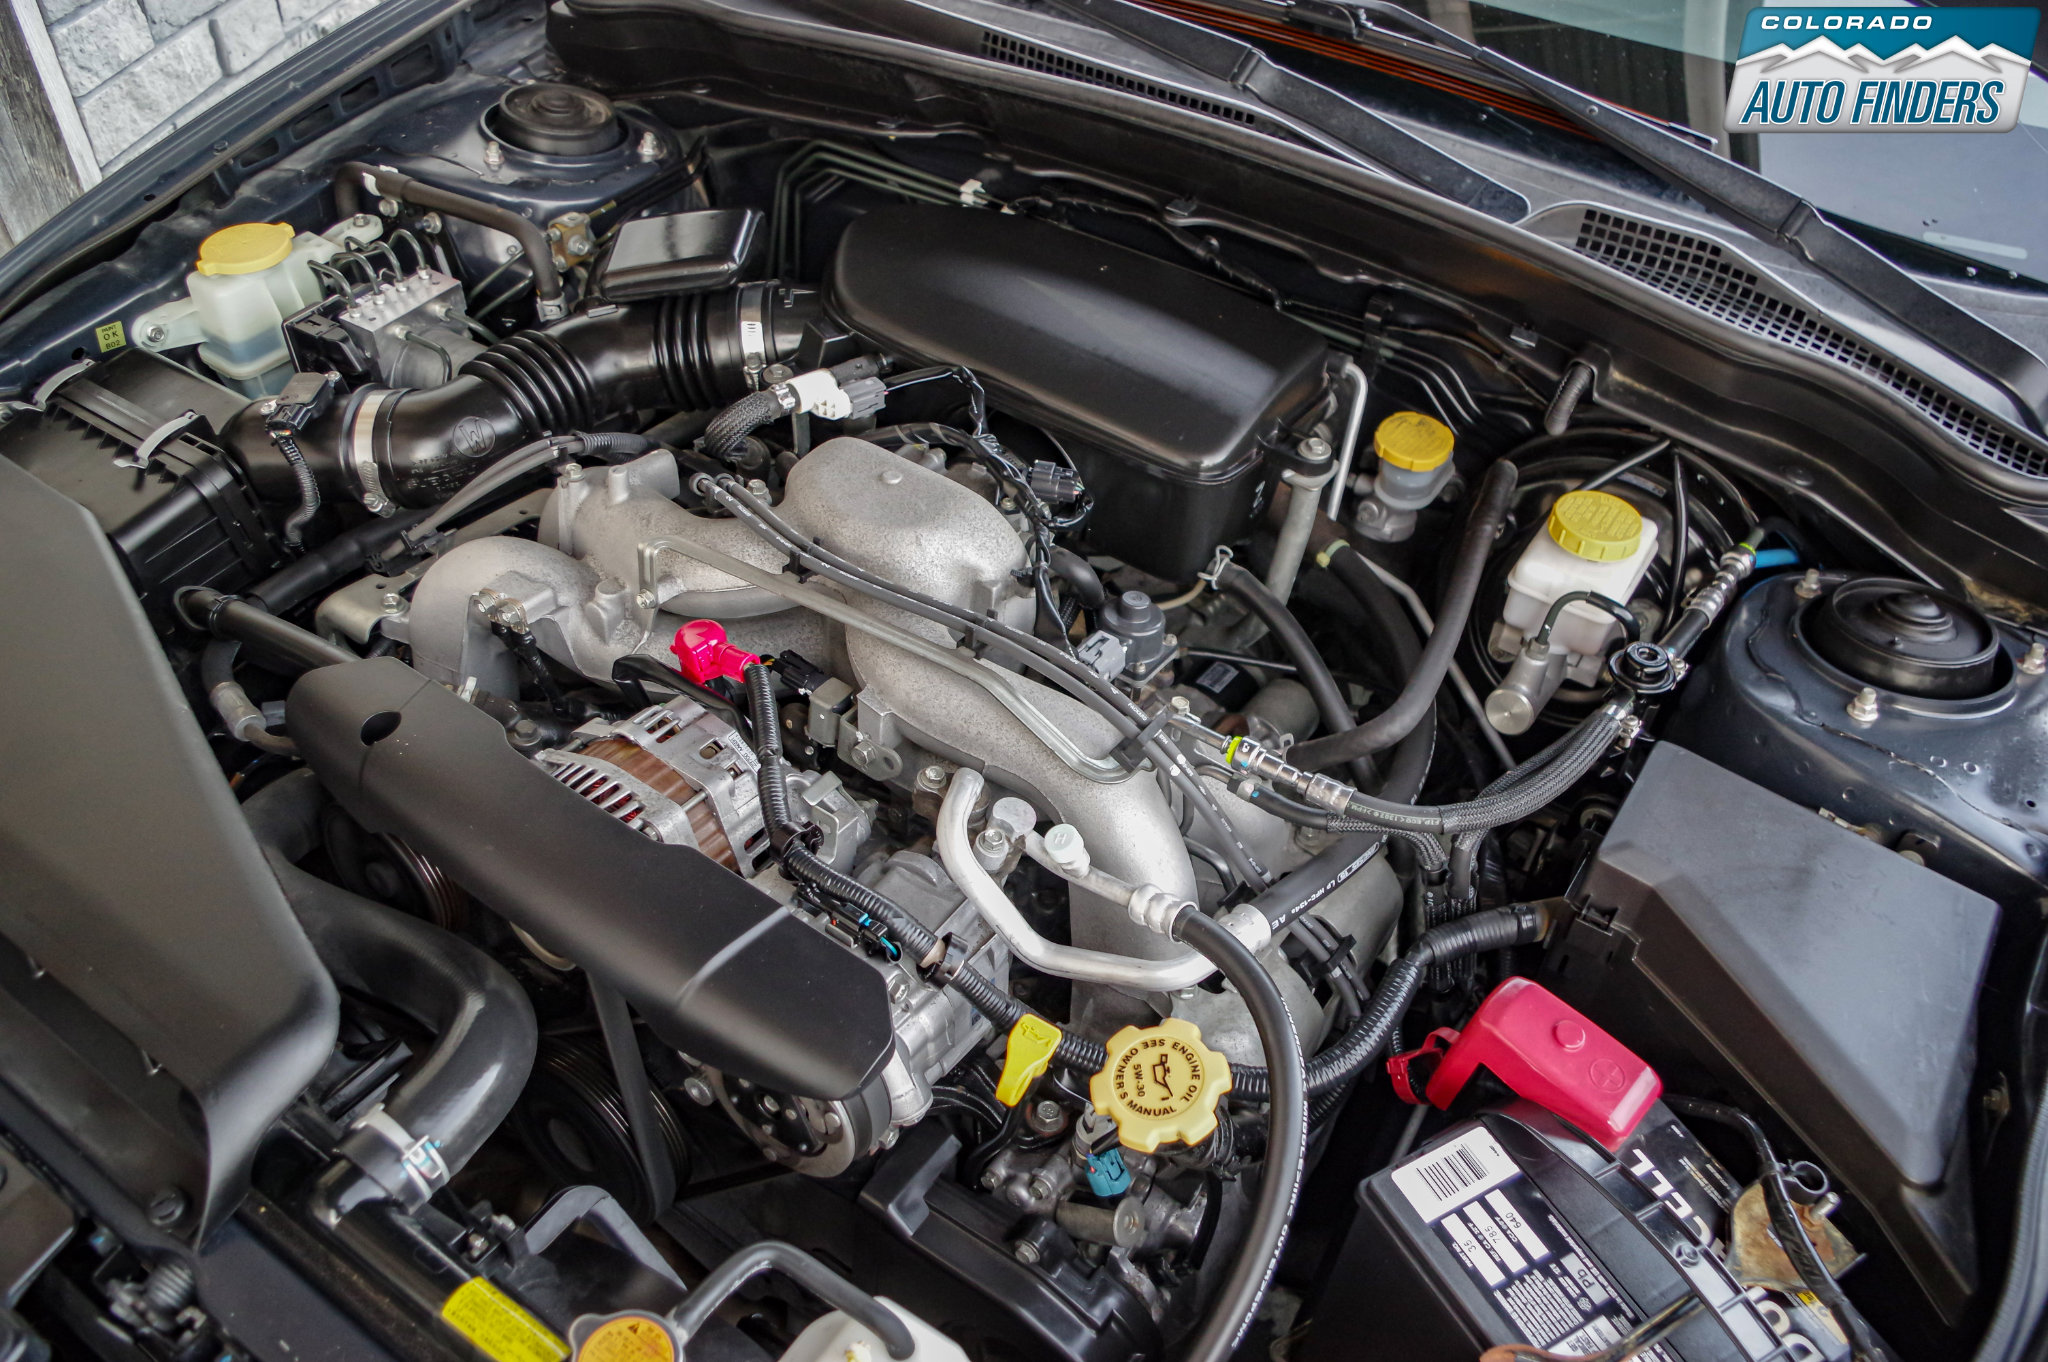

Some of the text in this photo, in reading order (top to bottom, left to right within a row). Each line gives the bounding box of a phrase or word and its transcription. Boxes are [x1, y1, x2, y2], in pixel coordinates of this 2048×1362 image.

[1054, 832, 1068, 845] H
[1141, 1038, 1166, 1050] SEE
[1133, 1063, 1146, 1098] 5W-30
[1171, 1041, 1201, 1103] ENGINE OIL
[1126, 1099, 1177, 1117] MANUAL
[1505, 1211, 1522, 1229] 640
[1484, 1224, 1502, 1244] 785
[1463, 1239, 1477, 1253] 35
[1574, 1267, 1595, 1290] Pb
